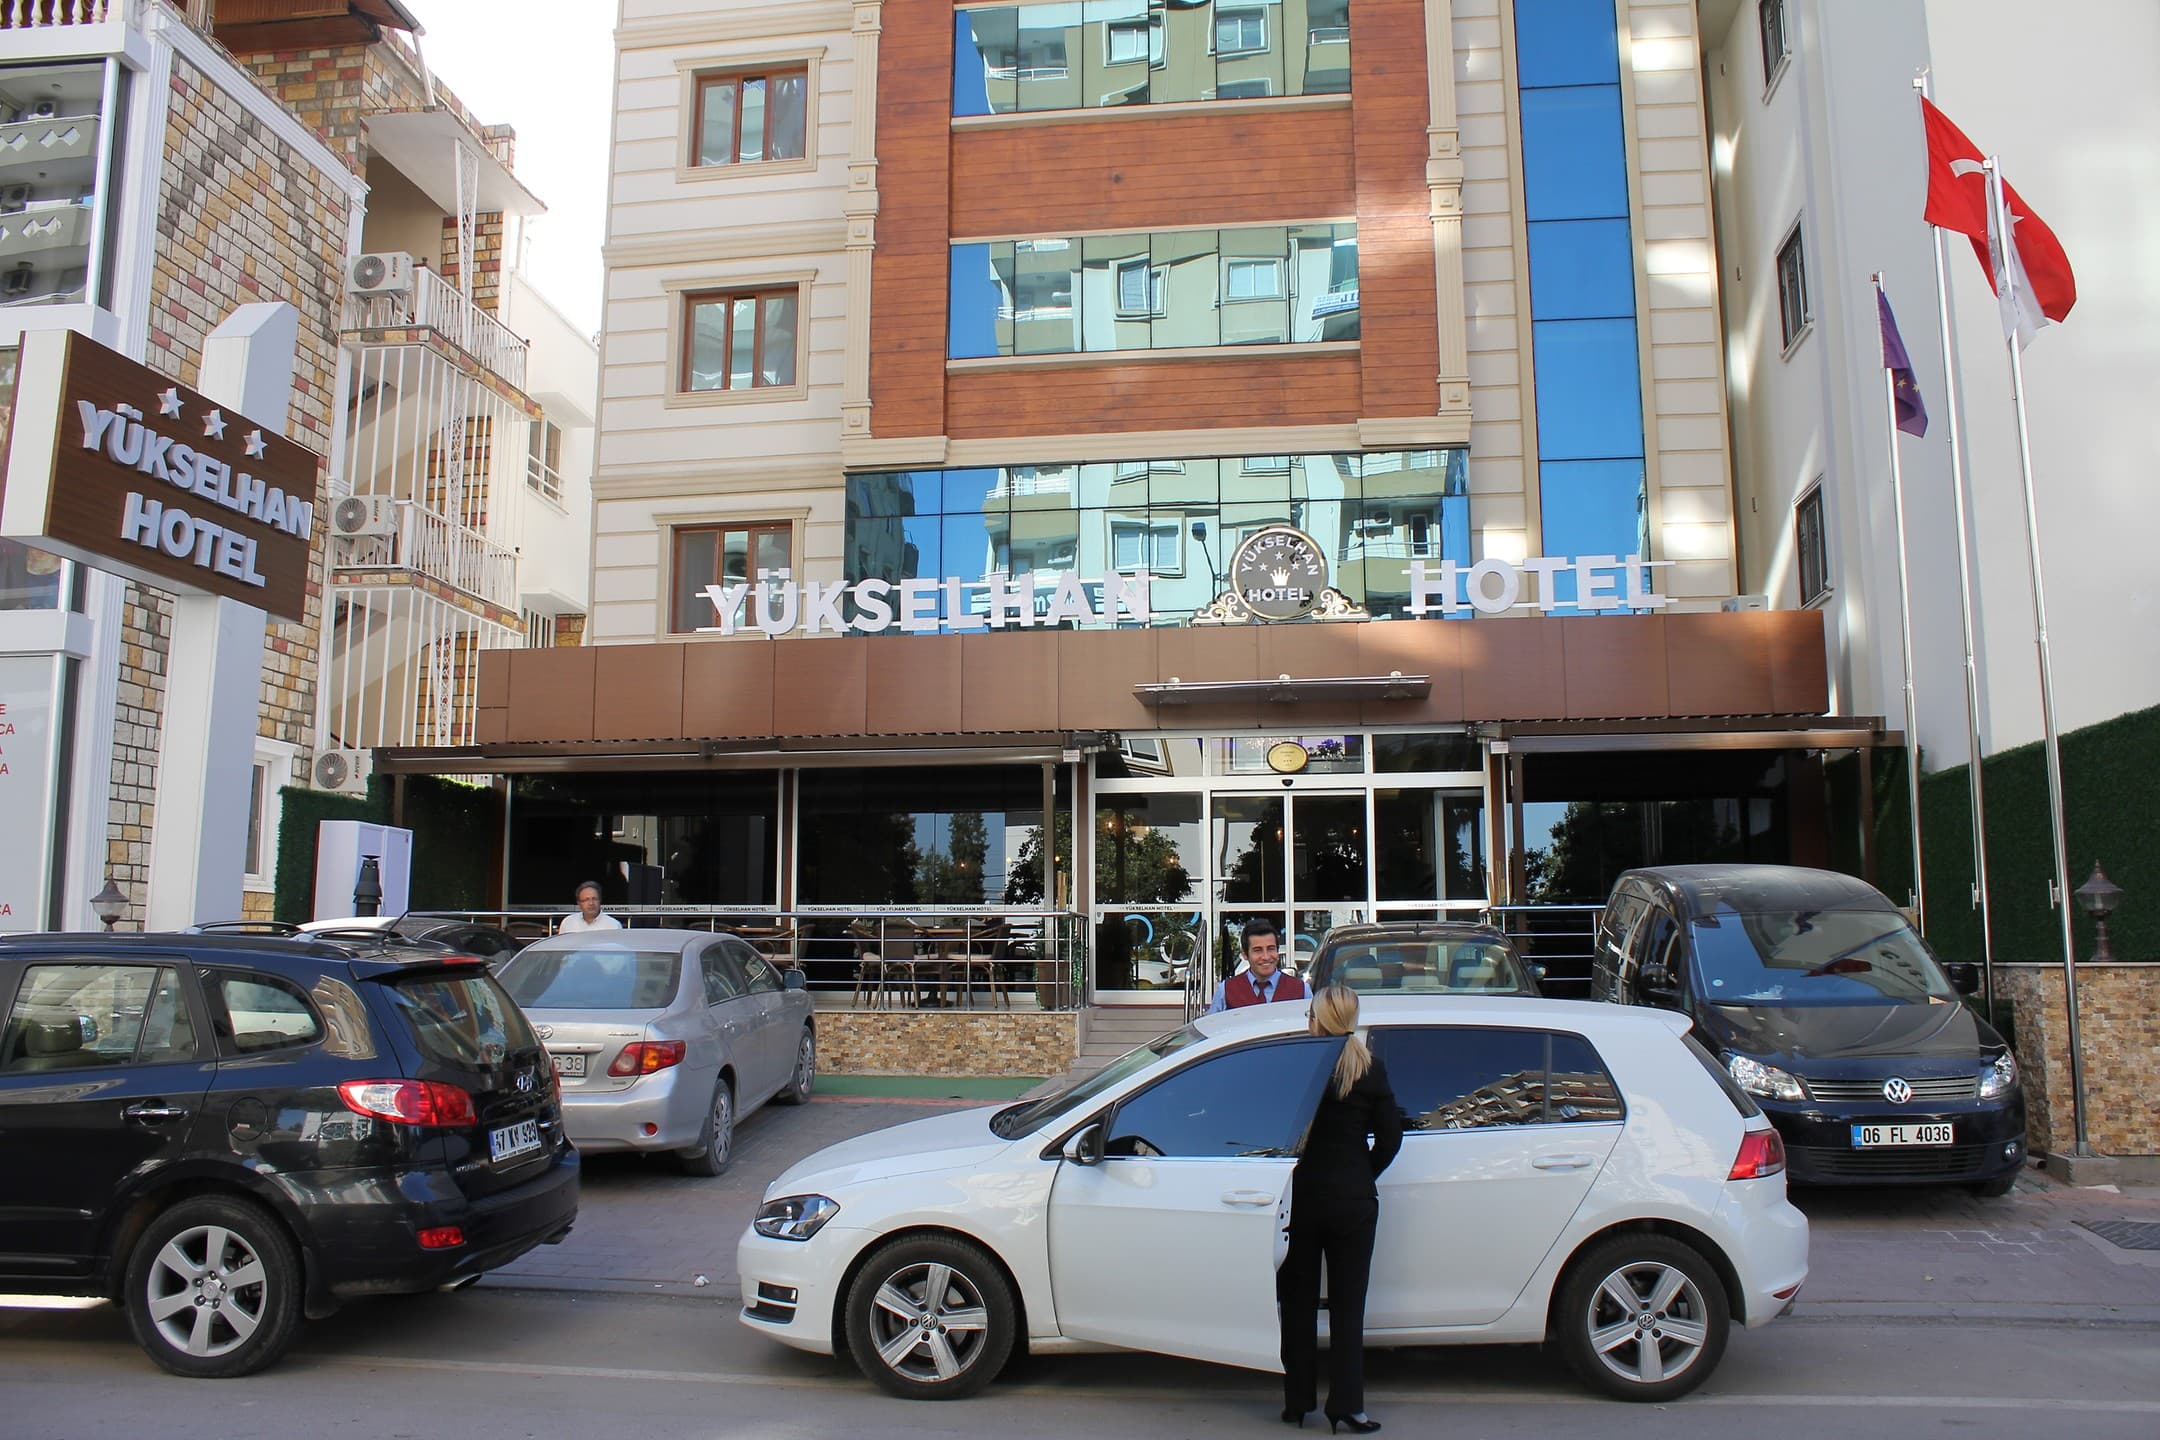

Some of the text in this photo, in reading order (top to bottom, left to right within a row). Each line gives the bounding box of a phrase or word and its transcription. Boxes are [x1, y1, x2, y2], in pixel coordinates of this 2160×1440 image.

[77, 400, 313, 541] YÜKSELHAN
[121, 492, 266, 588] HOTEL
[1241, 535, 1319, 576] YÜKSELHAN
[705, 567, 1151, 637] YÜKSELHAN
[1411, 554, 1666, 615] HOTEL
[1248, 587, 1309, 603] HOTEL
[566, 1056, 583, 1071] 38
[1863, 1127, 1880, 1143] 06
[1890, 1127, 1908, 1143] FL
[1916, 1126, 1950, 1142] 4036
